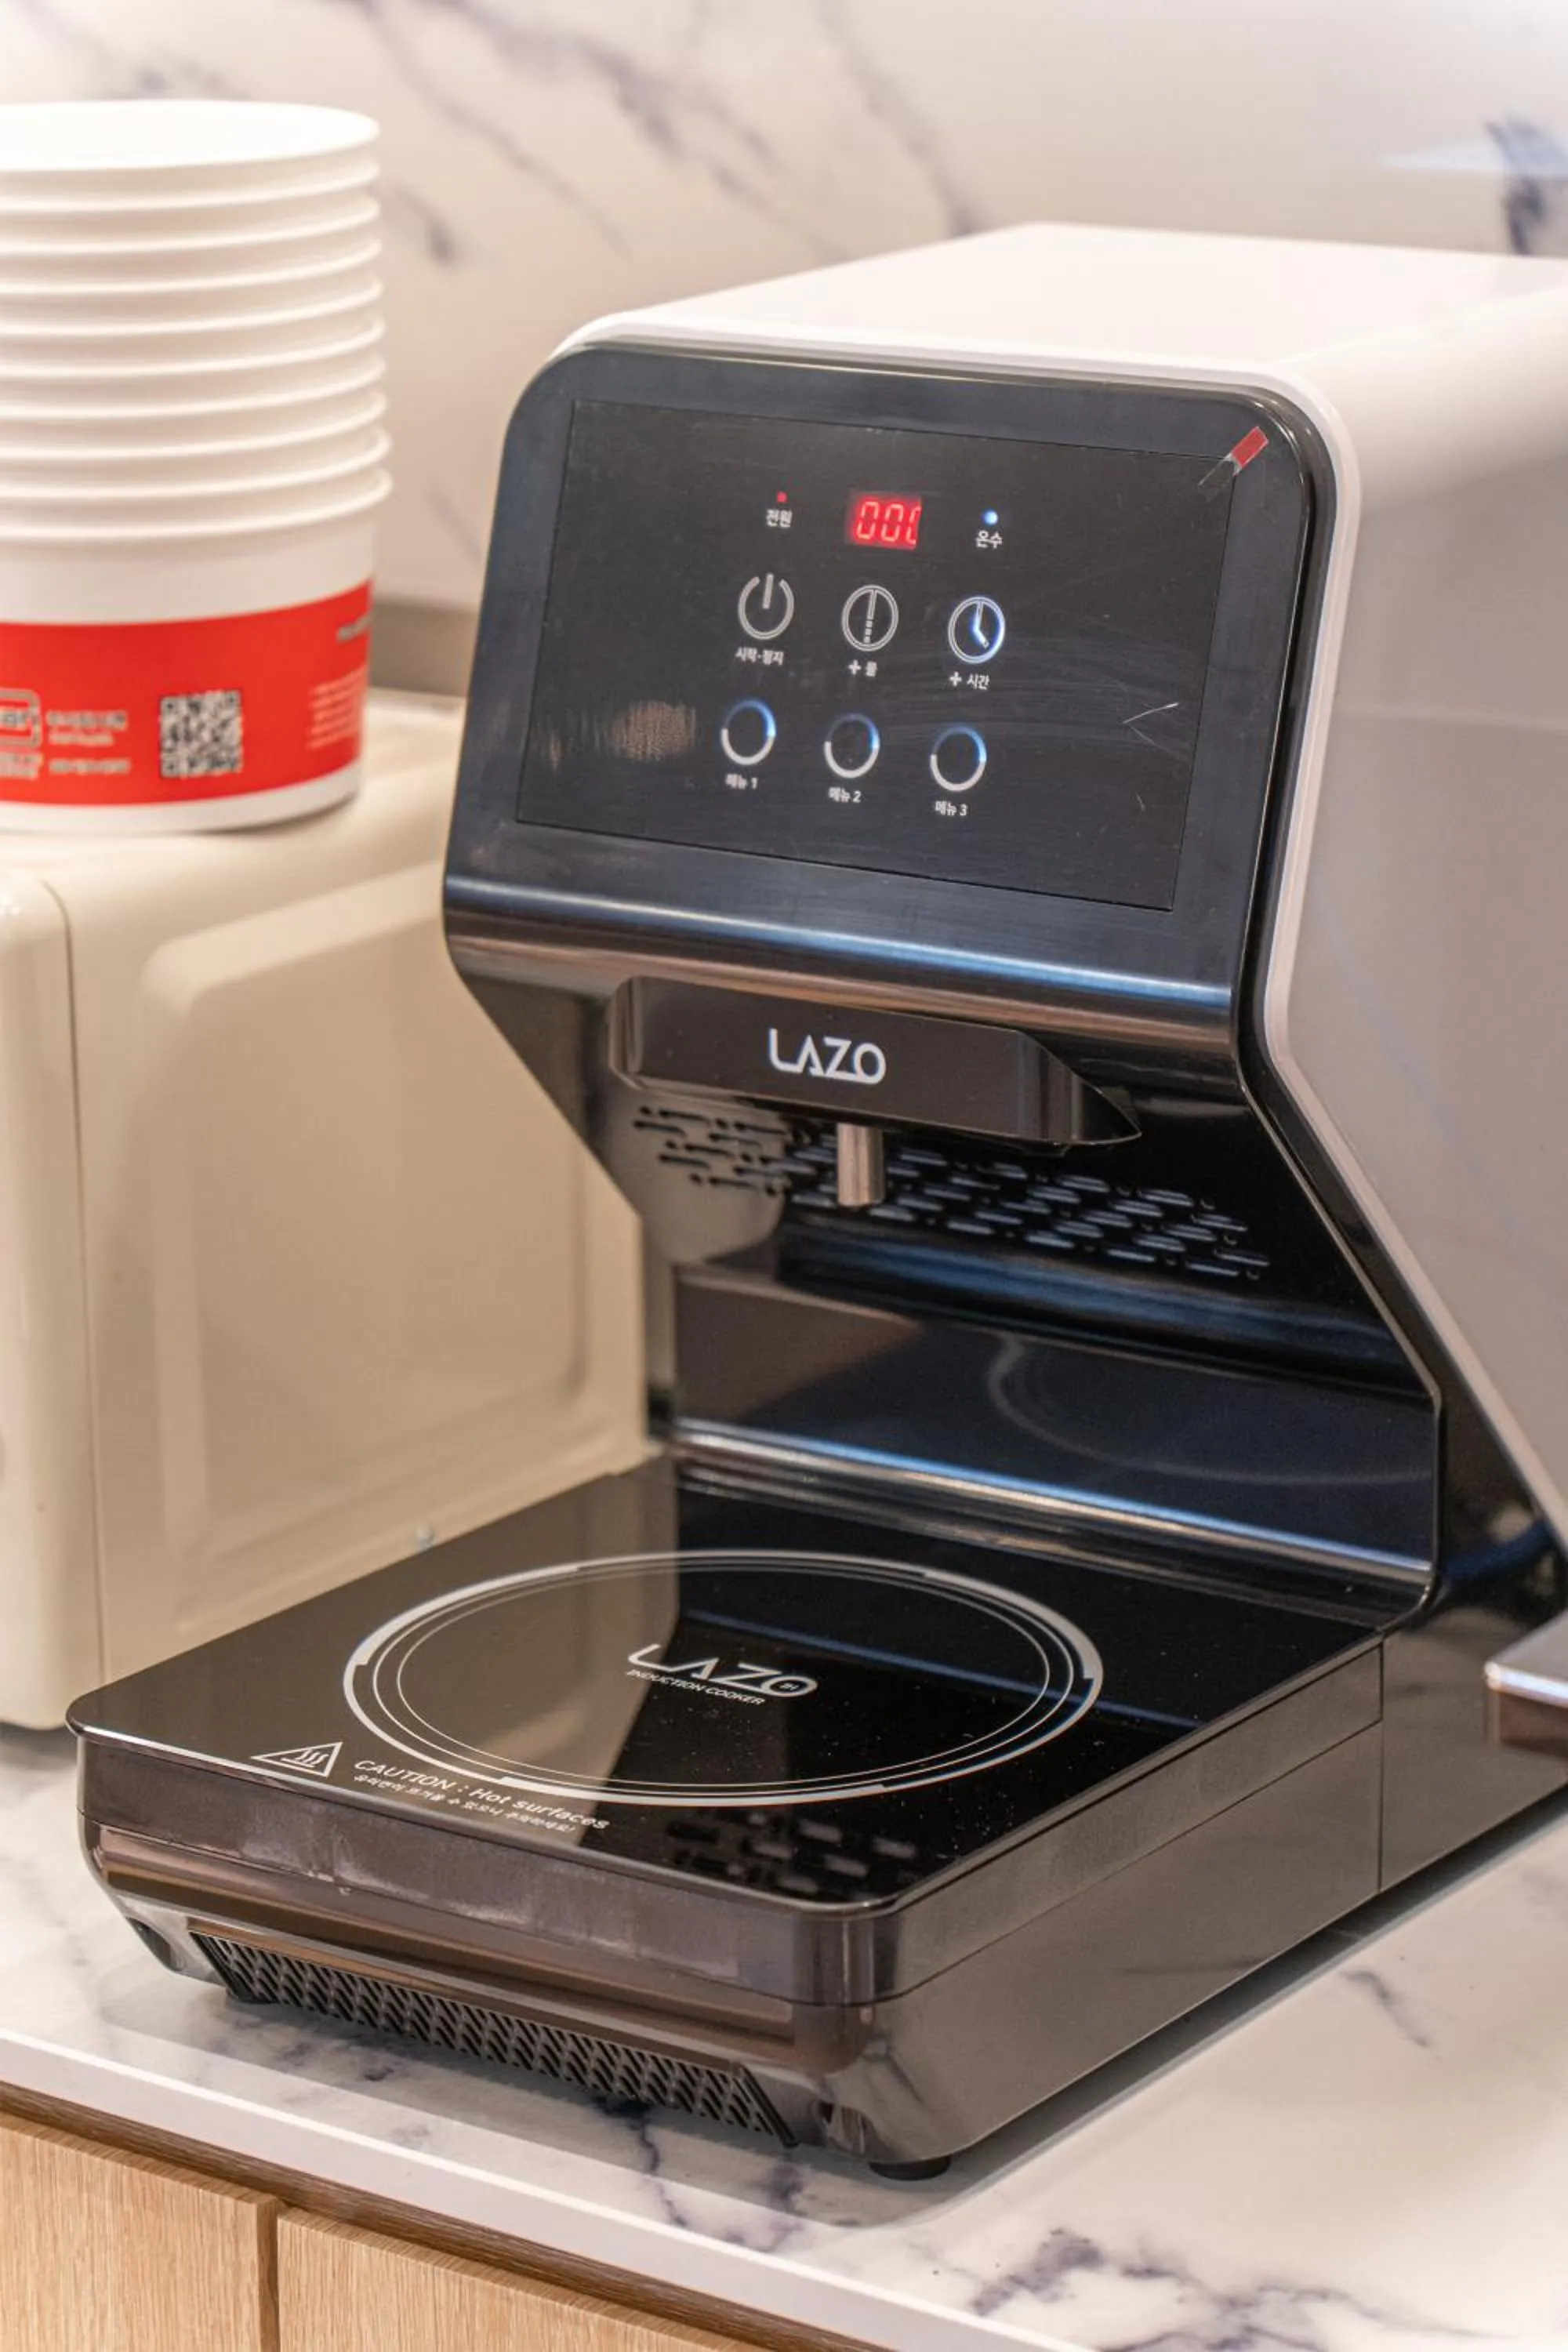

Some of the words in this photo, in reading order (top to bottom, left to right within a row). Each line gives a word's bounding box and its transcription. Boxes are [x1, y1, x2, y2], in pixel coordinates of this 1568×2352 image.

[766, 509, 792, 528] 전원
[975, 531, 1003, 549] 온수
[967, 674, 990, 690] 시간
[725, 773, 750, 789] 메뉴
[751, 777, 758, 789] 1
[828, 786, 851, 802] 메뉴
[851, 790, 862, 803] 2
[935, 800, 957, 816] 메뉴
[958, 804, 968, 816] 3
[768, 1028, 887, 1084] LAZO
[627, 1643, 818, 1697] LAZO
[626, 1669, 705, 1692] INDUCTION
[705, 1686, 766, 1705] COOKER
[354, 1760, 458, 1790] CAUTION
[469, 1788, 512, 1803] Hot
[513, 1800, 610, 1829] surfaces
